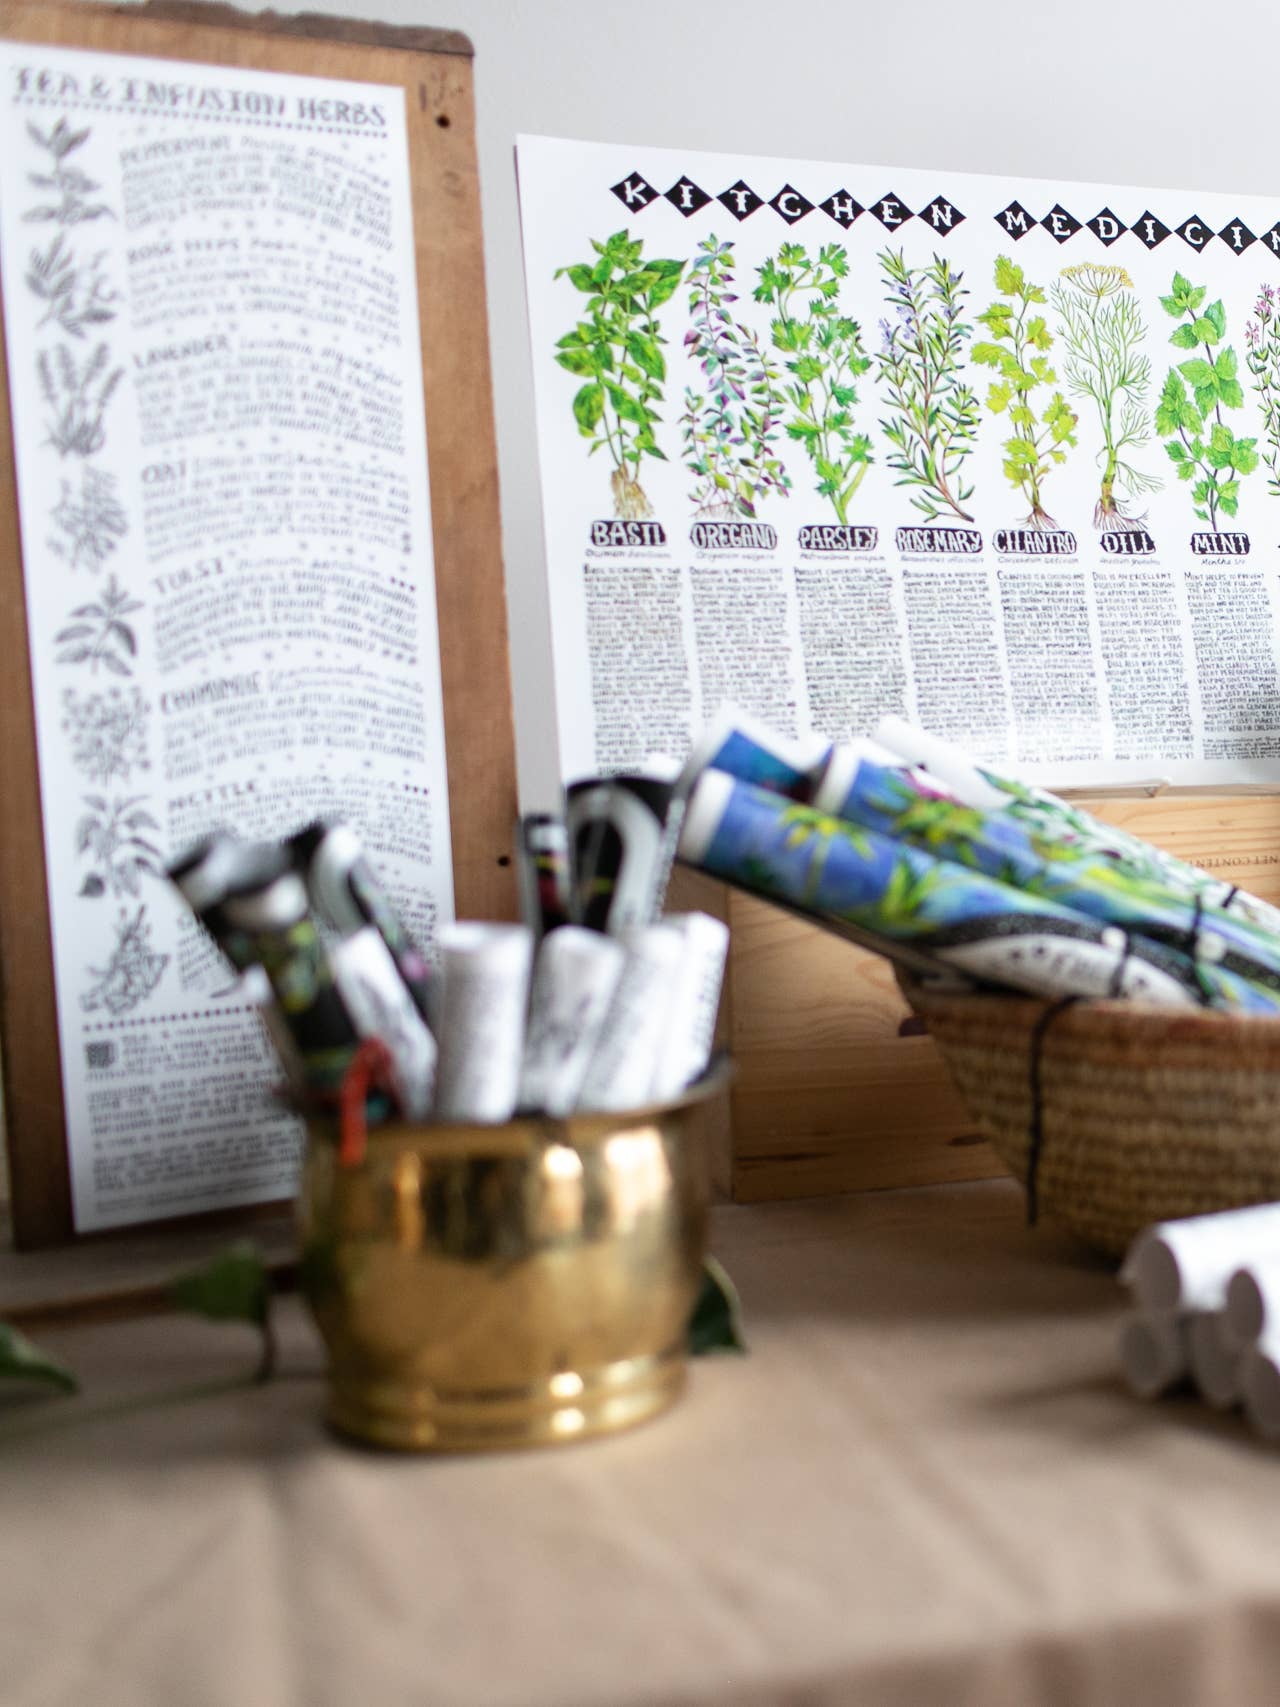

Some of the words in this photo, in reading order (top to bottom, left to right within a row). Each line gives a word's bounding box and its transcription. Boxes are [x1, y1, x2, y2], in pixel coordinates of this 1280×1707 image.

[14, 66, 80, 97] TEA
[89, 74, 111, 98] &
[122, 77, 286, 115] INFUSION
[296, 97, 388, 128] HERBS
[622, 178, 956, 229] KITCHEN
[592, 522, 666, 546] BASIL
[691, 523, 777, 549] OREGANO
[800, 527, 877, 550] PARSLEY
[897, 529, 982, 552] ROSEMARY
[993, 530, 1076, 554] CILANTRO
[1103, 533, 1156, 554] DILL
[1193, 533, 1248, 554] MINT
